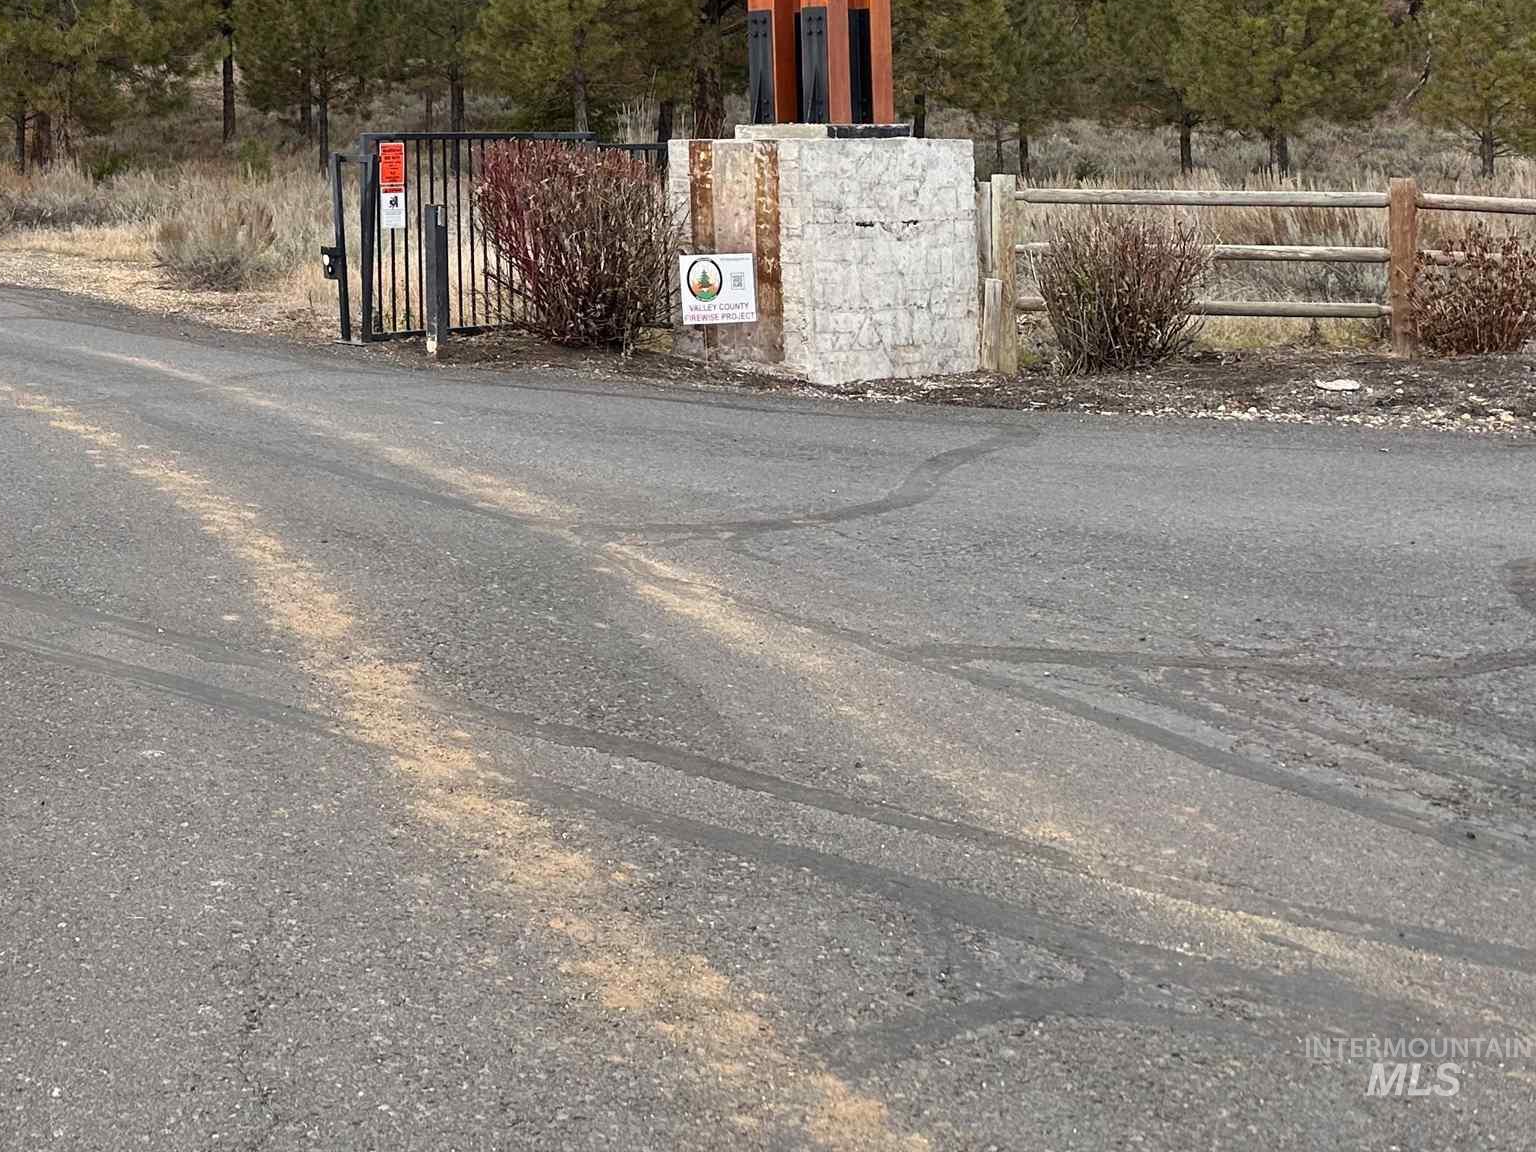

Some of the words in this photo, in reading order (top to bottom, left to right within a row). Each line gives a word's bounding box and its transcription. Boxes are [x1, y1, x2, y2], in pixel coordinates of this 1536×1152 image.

[689, 304, 717, 312] VALLEY
[719, 303, 750, 311] COUNTY
[721, 312, 754, 320] PROJECT
